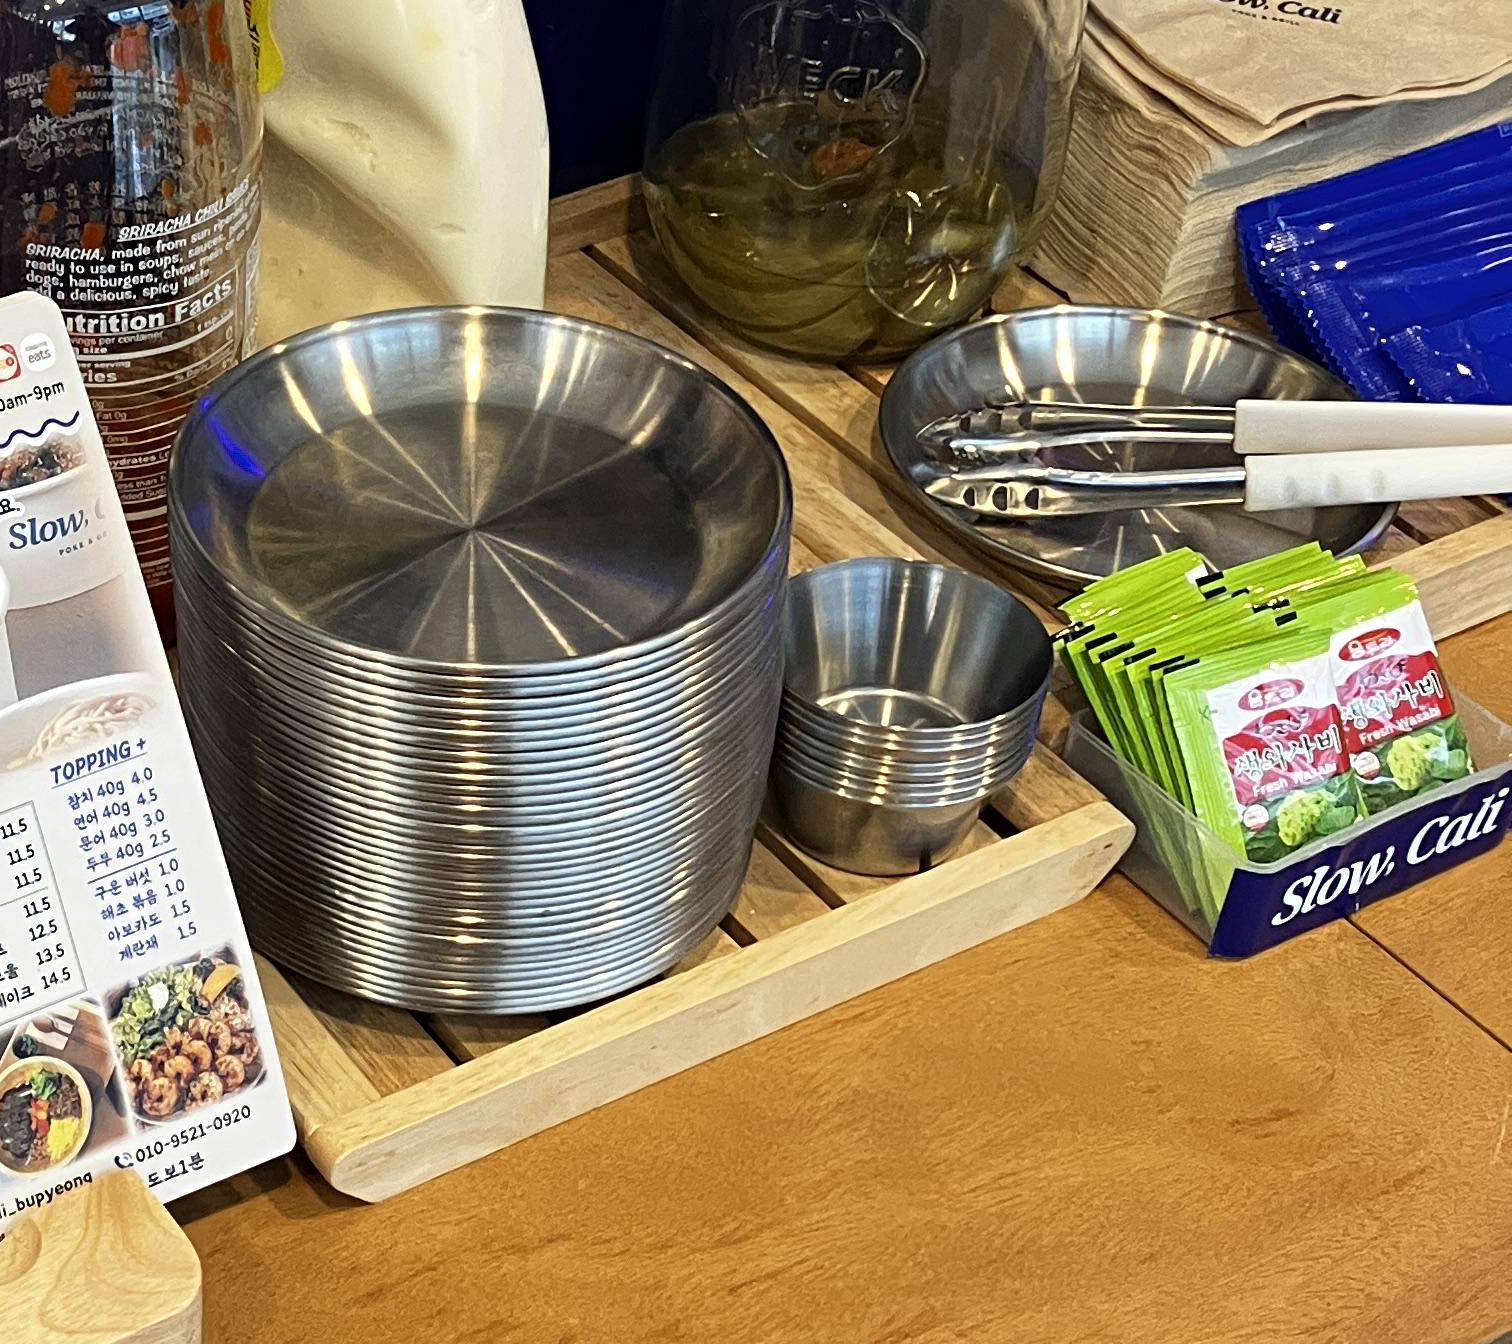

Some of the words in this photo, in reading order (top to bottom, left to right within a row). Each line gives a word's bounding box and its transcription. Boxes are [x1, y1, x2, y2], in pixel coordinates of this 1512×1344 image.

[1277, 1, 1342, 24] Cali
[119, 214, 191, 239] SRIRACHA
[112, 244, 150, 259] made
[156, 238, 186, 253] from
[26, 259, 64, 276] ready
[70, 262, 84, 273] to
[90, 264, 115, 274] use
[143, 280, 178, 299] spicy
[175, 278, 232, 323] Facts
[1359, 728, 1392, 745] Fresh
[1397, 708, 1441, 730] Wasabi
[50, 740, 131, 784] TOPPING
[68, 788, 93, 810] 참치
[97, 780, 124, 797] 40g
[132, 767, 152, 784] 4.0
[74, 809, 98, 830] 연어
[137, 788, 157, 805] 4.5
[0, 818, 28, 840] 11.5
[79, 830, 105, 851] 문어
[143, 809, 164, 827] 3.0
[1407, 787, 1510, 864] Cali
[7, 844, 35, 866] 11.5
[86, 851, 112, 872] 두부
[150, 830, 171, 848] 2.5
[95, 880, 122, 900] 구운
[126, 867, 151, 886] 버섯
[159, 859, 179, 876] 1.0
[101, 903, 128, 920] 해초
[133, 889, 157, 909] 볶음
[108, 913, 162, 940] 아보카도
[171, 899, 191, 918] 1.5
[29, 919, 58, 942] 12.5
[36, 943, 65, 965] 13.5
[119, 935, 158, 961] 계란채
[40, 967, 71, 990] 14.5
[135, 1105, 251, 1164] 010-9521-0920
